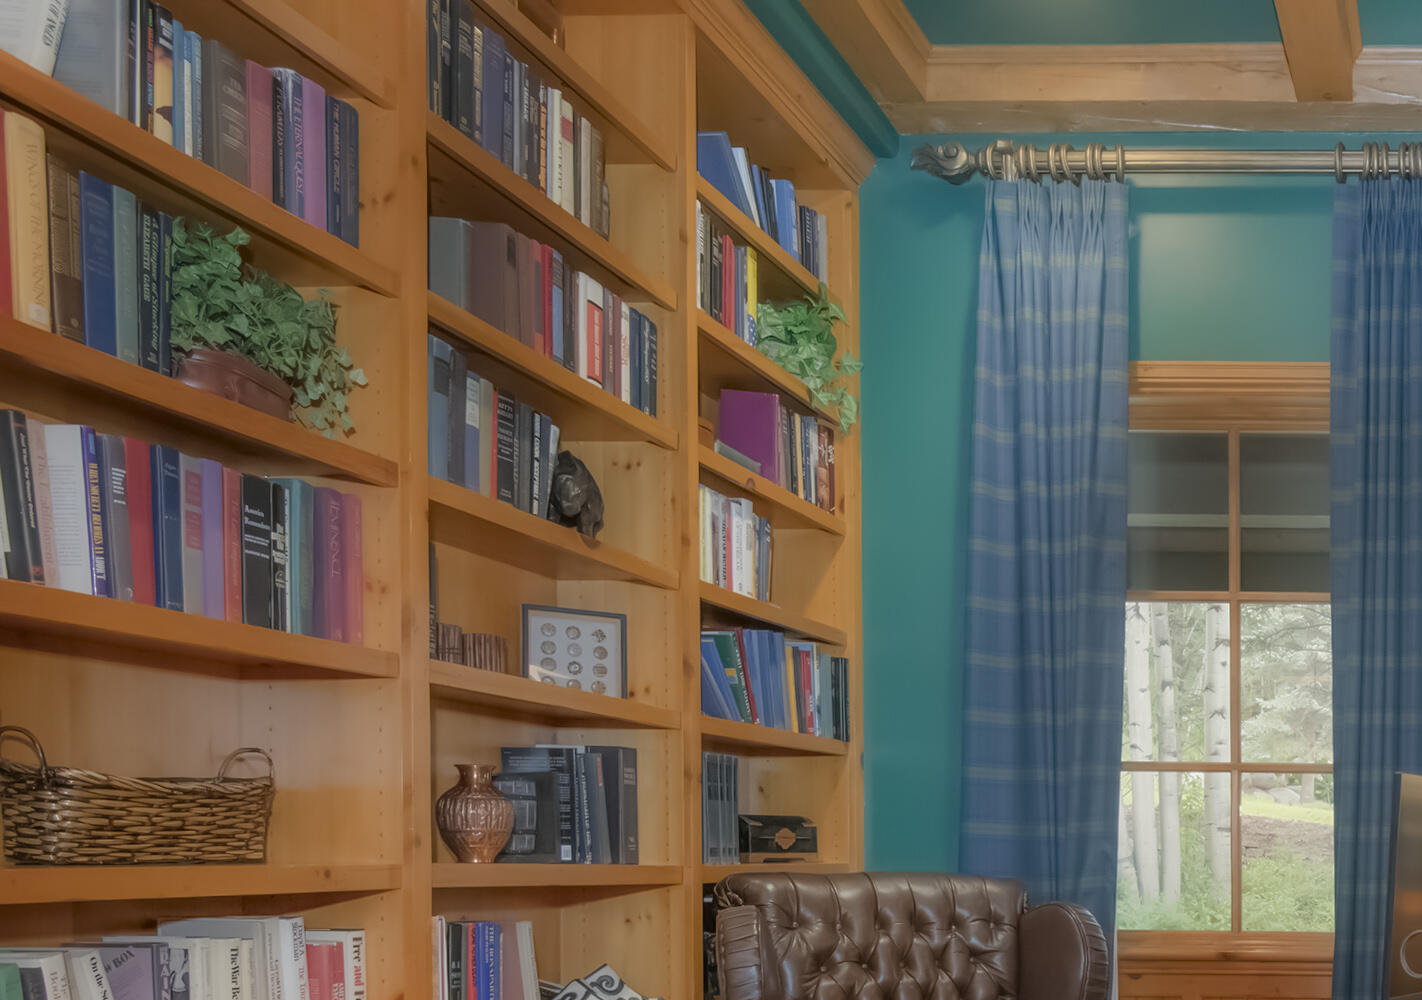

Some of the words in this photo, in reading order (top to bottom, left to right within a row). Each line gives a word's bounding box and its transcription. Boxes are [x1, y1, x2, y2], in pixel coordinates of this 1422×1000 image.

[142, 213, 150, 271] ELIZABETH
[150, 230, 159, 282] Glimpse
[230, 946, 239, 965] The
[352, 936, 363, 962] Free
[230, 964, 239, 985] War
[353, 964, 363, 986] and
